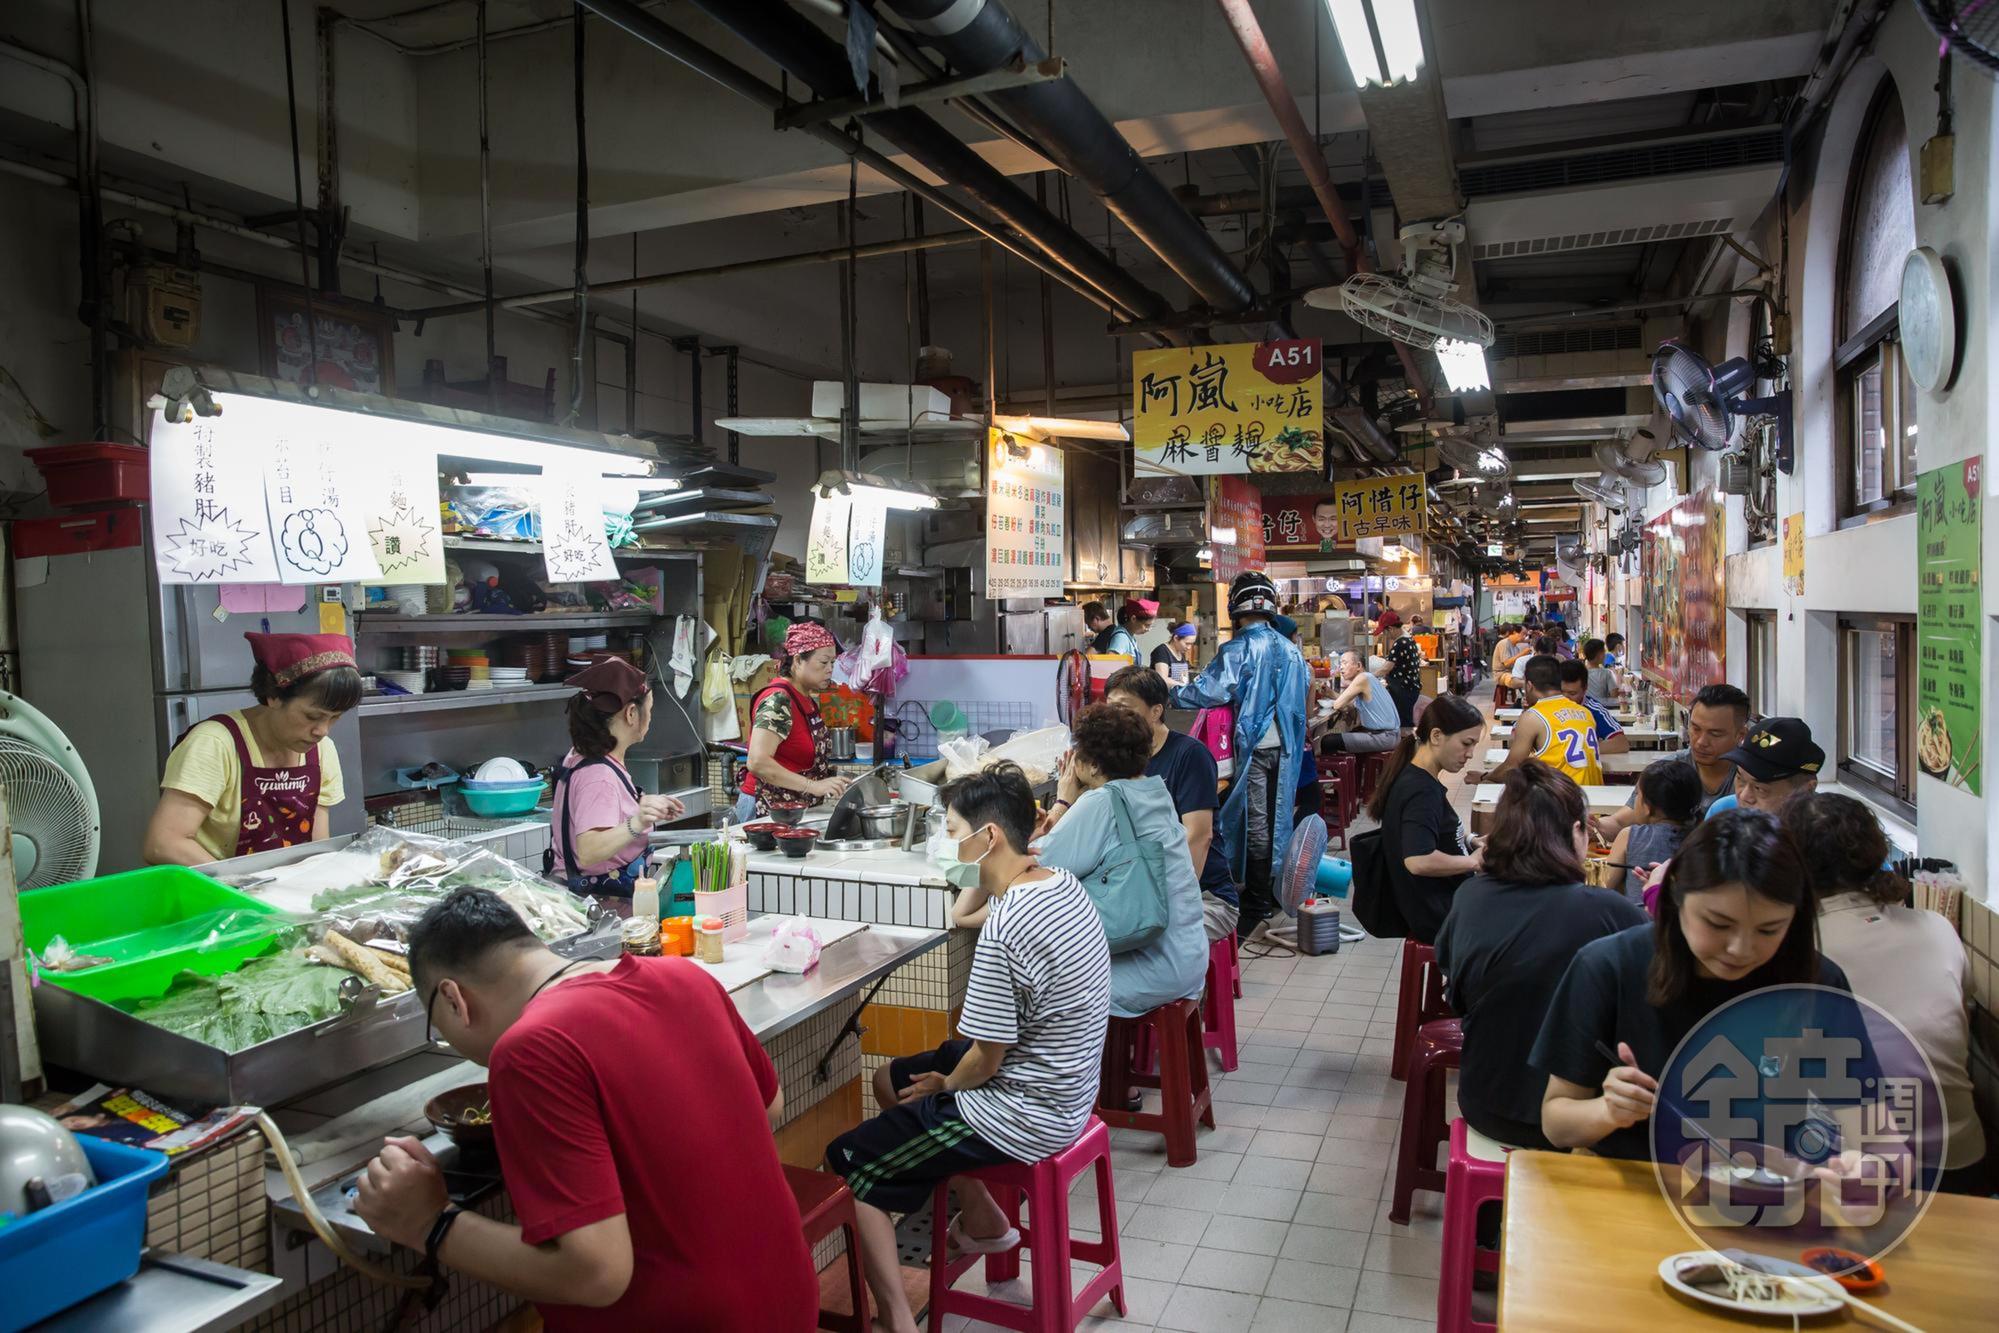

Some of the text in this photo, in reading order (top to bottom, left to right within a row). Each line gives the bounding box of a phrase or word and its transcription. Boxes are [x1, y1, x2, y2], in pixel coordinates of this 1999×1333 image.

[1268, 345, 1313, 367] A51
[1140, 352, 1314, 418] 阿嵐 小吃店
[1341, 483, 1423, 516] 阿惜仔
[1353, 514, 1412, 536] 古早味
[189, 538, 228, 557] 好吃
[563, 549, 586, 562] 好吃
[1557, 727, 1602, 768] 24
[259, 779, 308, 795] yummy
